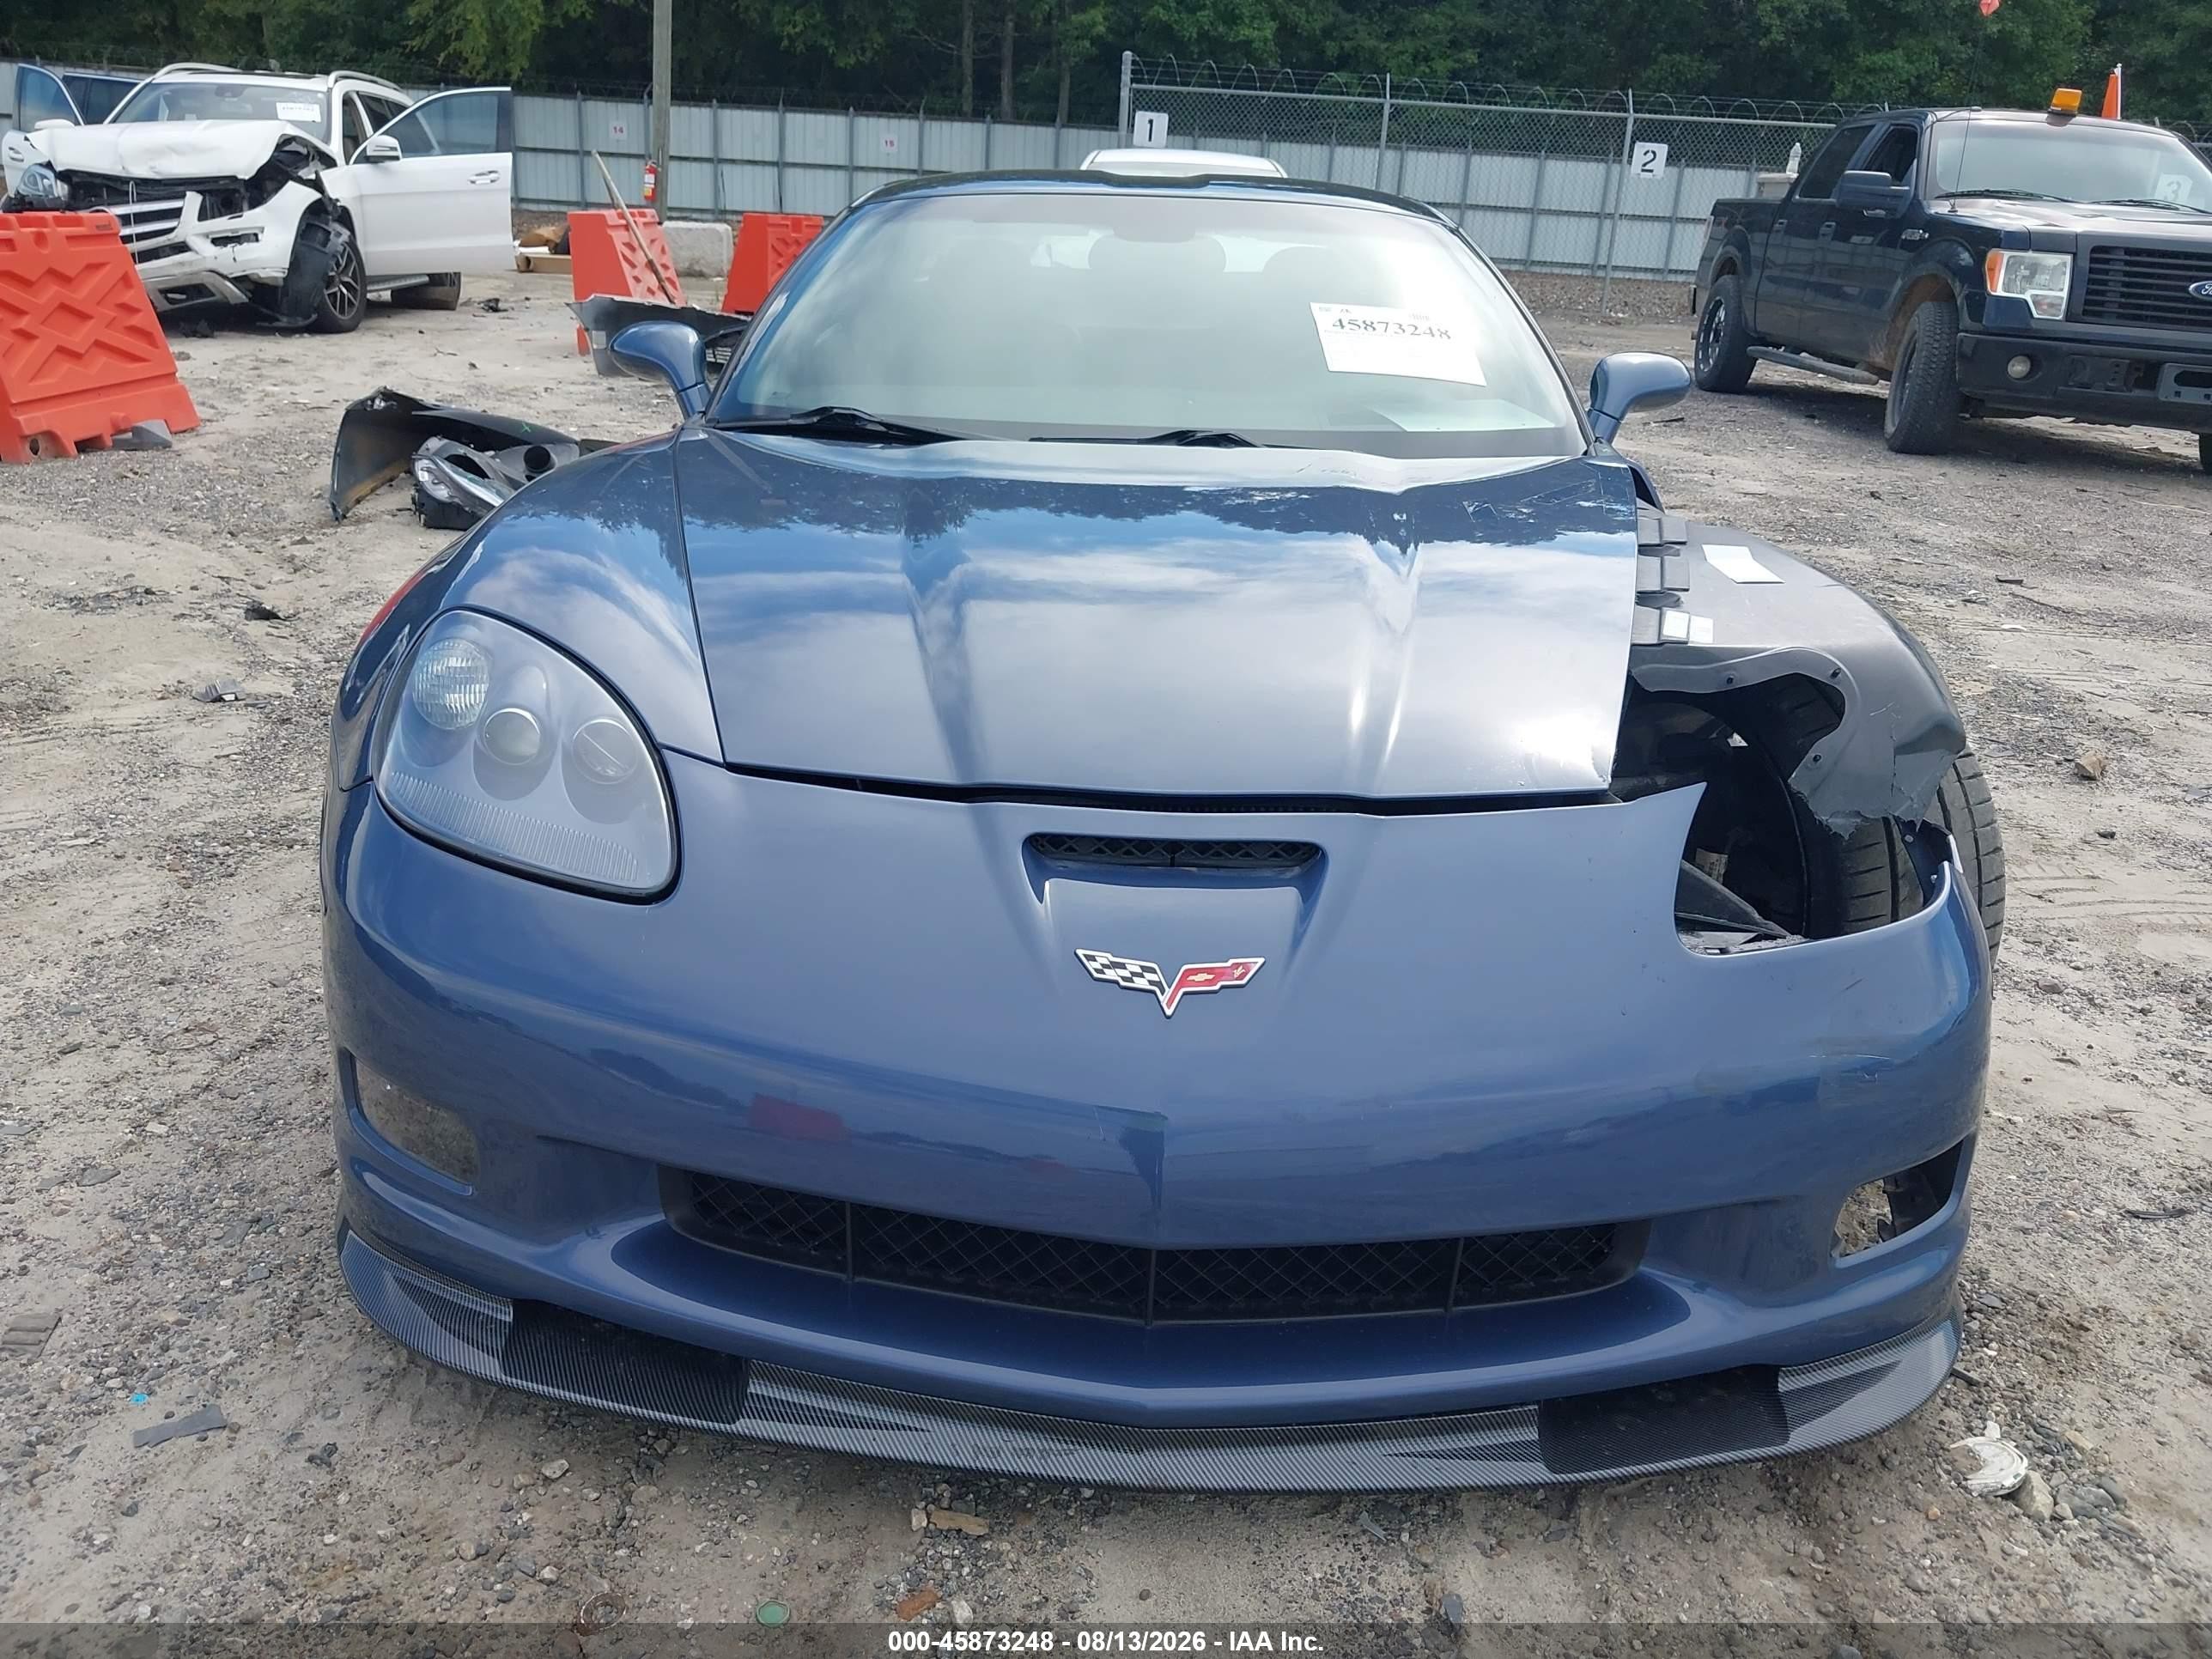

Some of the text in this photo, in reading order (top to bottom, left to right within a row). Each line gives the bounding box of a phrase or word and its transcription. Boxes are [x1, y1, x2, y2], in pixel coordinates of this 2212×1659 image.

[1148, 118, 1154, 142] 1
[1641, 149, 1657, 173] 2
[2164, 180, 2182, 202] 3
[1332, 317, 1452, 340] 45873248
